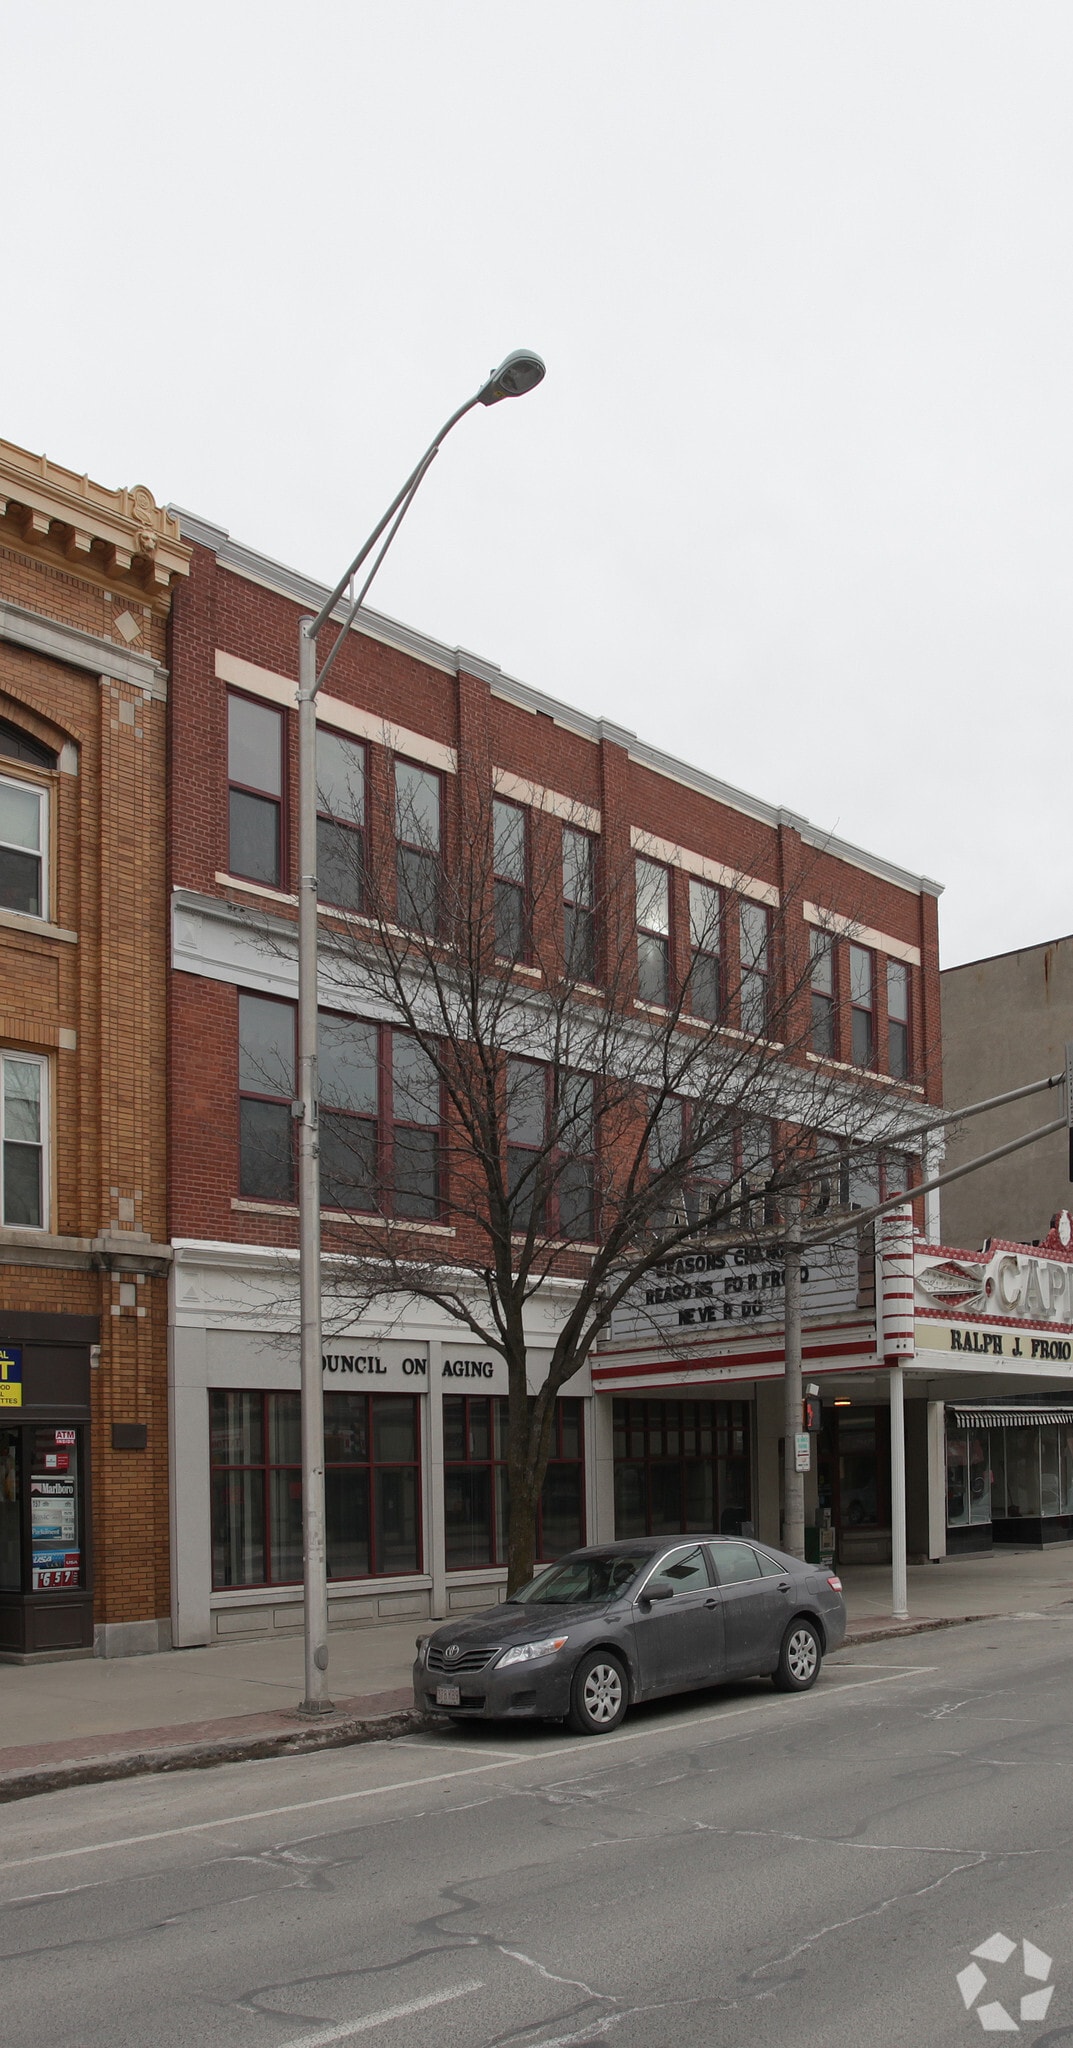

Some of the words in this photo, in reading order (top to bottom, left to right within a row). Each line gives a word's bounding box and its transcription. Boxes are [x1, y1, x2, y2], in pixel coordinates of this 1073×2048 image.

[950, 1329, 1004, 1354] RALPH
[1012, 1337, 1023, 1357] J.
[1031, 1338, 1072, 1361] FROIO
[322, 1354, 387, 1374] UNCIL
[402, 1358, 427, 1375] ON
[442, 1360, 494, 1378] AGING
[56, 1430, 75, 1439] ATM
[41, 1483, 74, 1494] Marlboro
